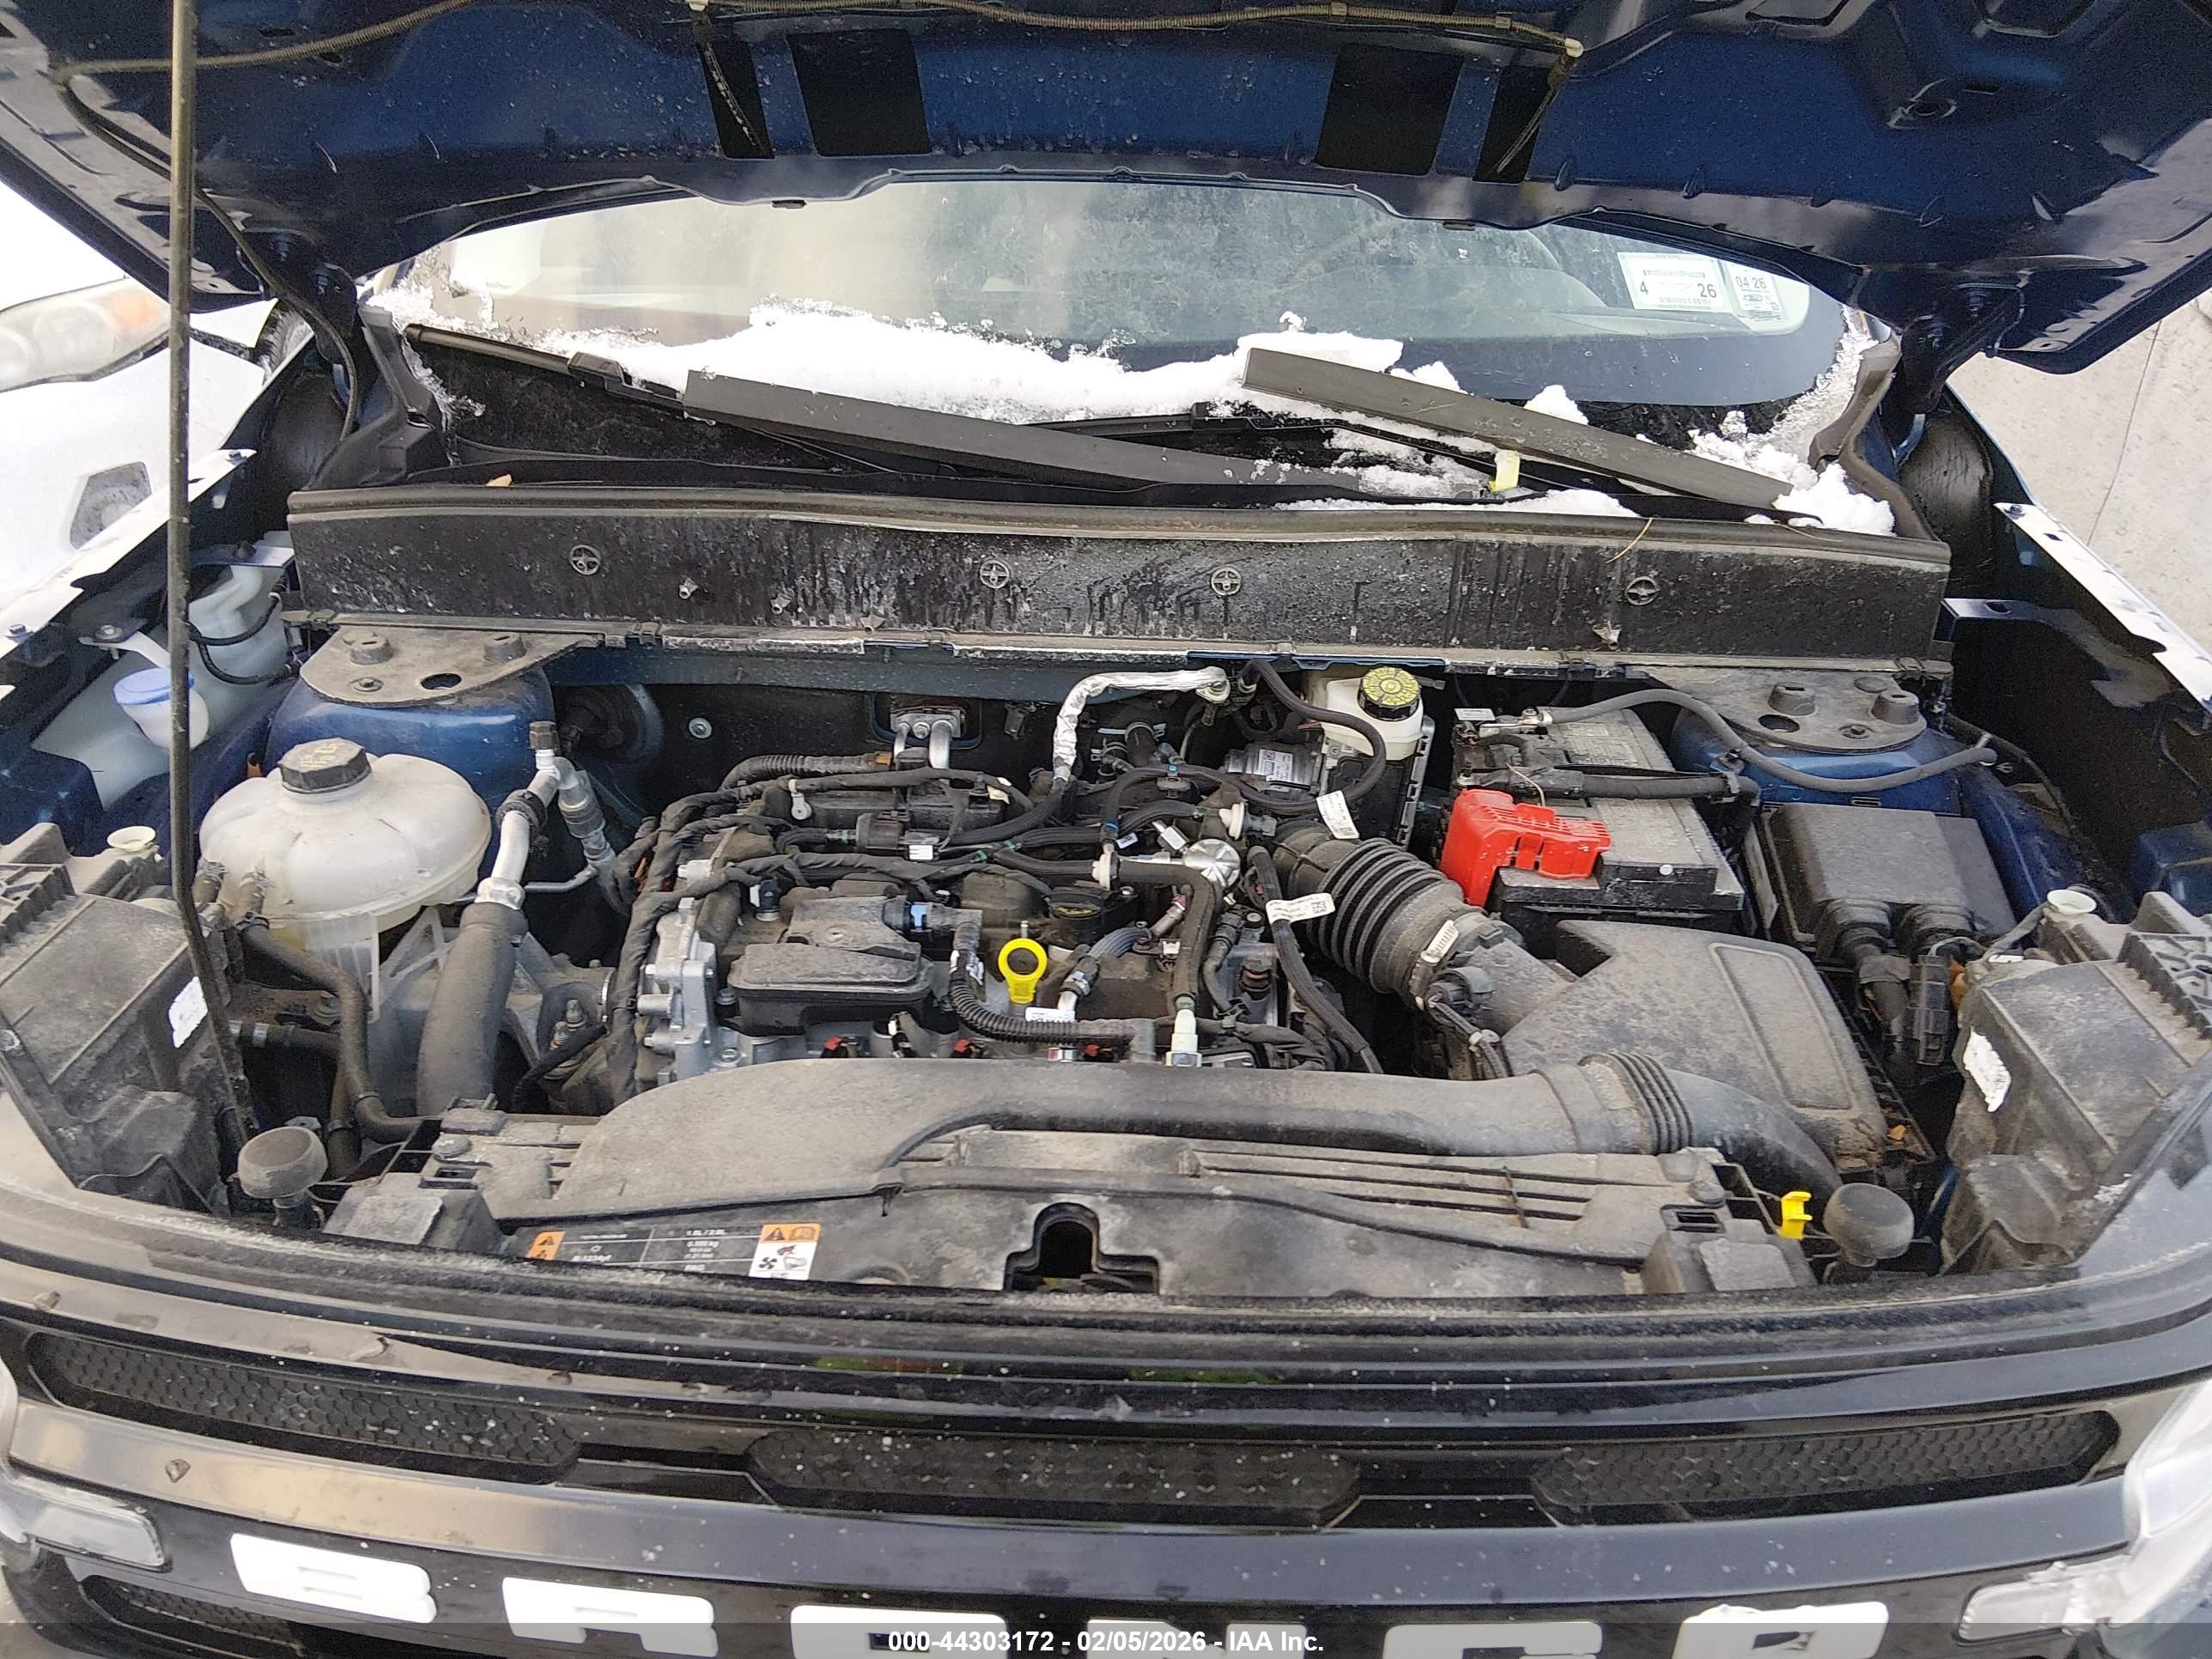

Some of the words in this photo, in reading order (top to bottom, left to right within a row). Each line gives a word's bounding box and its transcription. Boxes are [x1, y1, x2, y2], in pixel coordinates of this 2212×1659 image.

[1640, 282, 1649, 295] 4
[1735, 276, 1749, 289] 04
[1753, 276, 1766, 289] 26
[1697, 283, 1717, 298] 26
